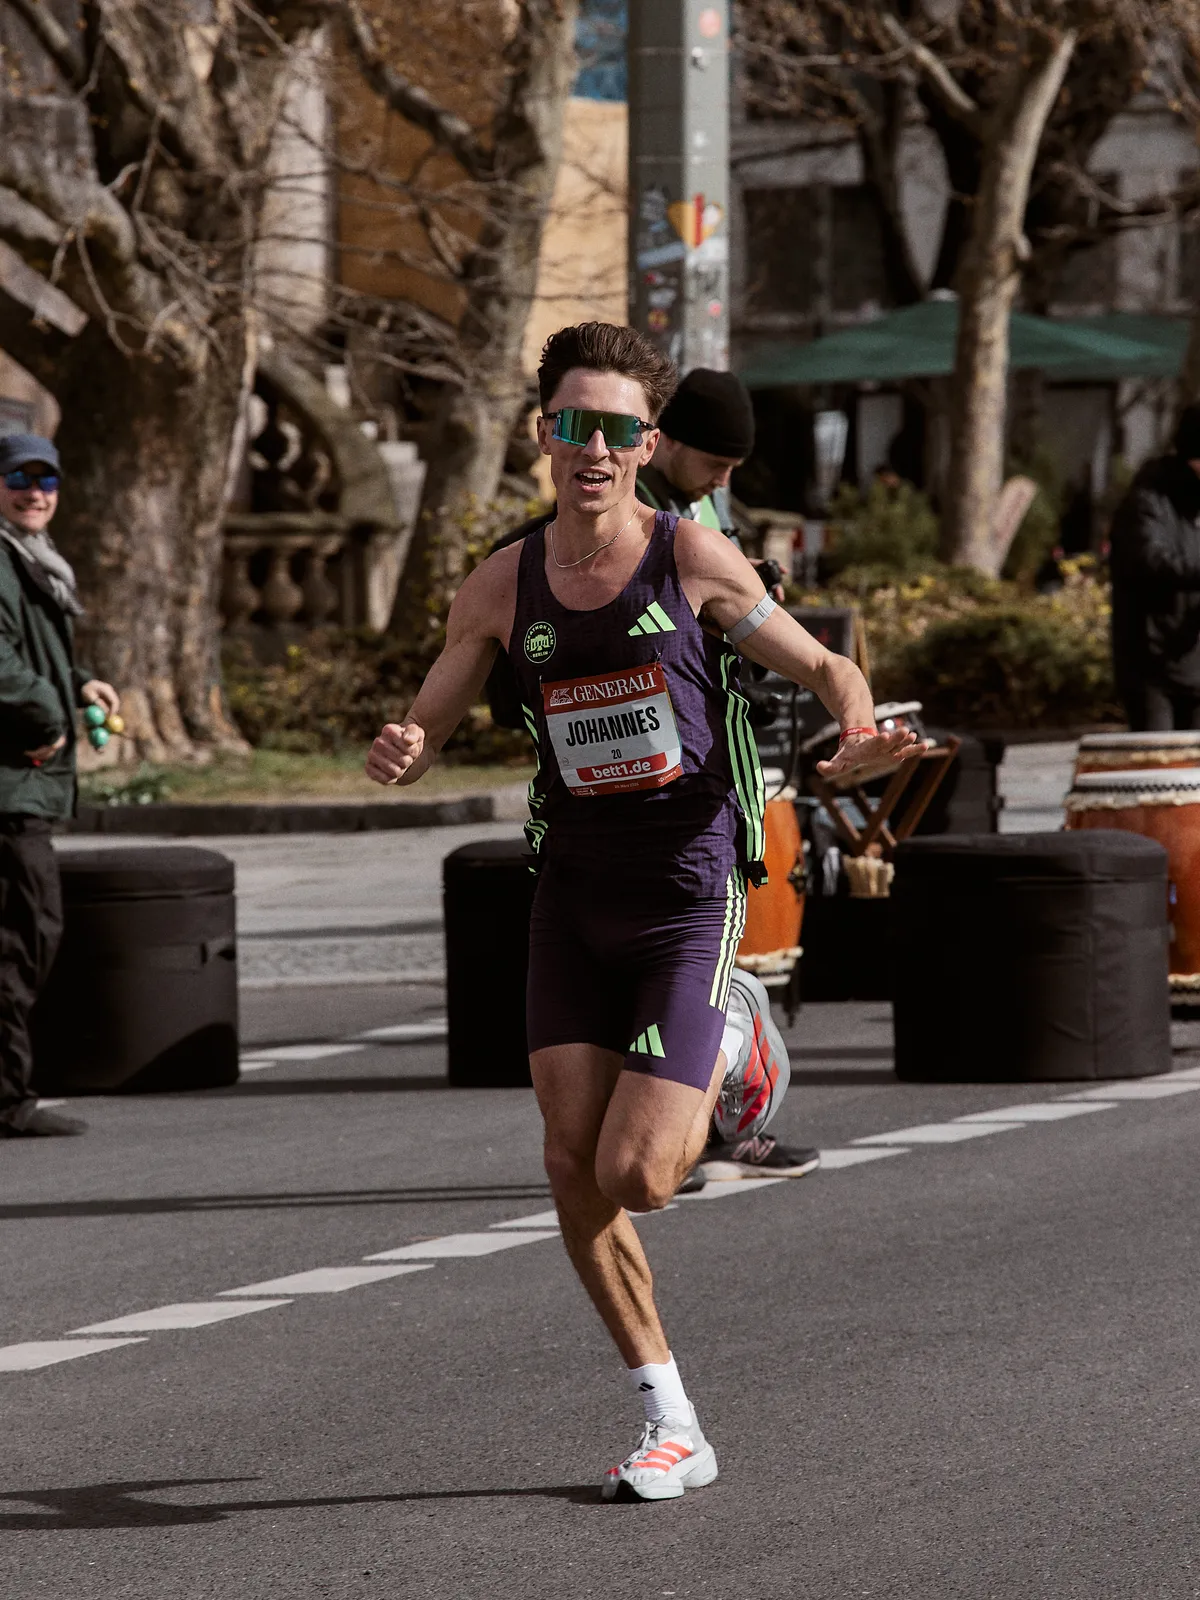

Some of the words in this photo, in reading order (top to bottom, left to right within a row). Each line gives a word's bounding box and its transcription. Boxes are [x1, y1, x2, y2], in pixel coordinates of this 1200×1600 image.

[573, 671, 657, 702] GENERALI
[565, 705, 660, 747] JOHANNES
[611, 748, 622, 760] 20
[591, 760, 651, 779] bett1.de
